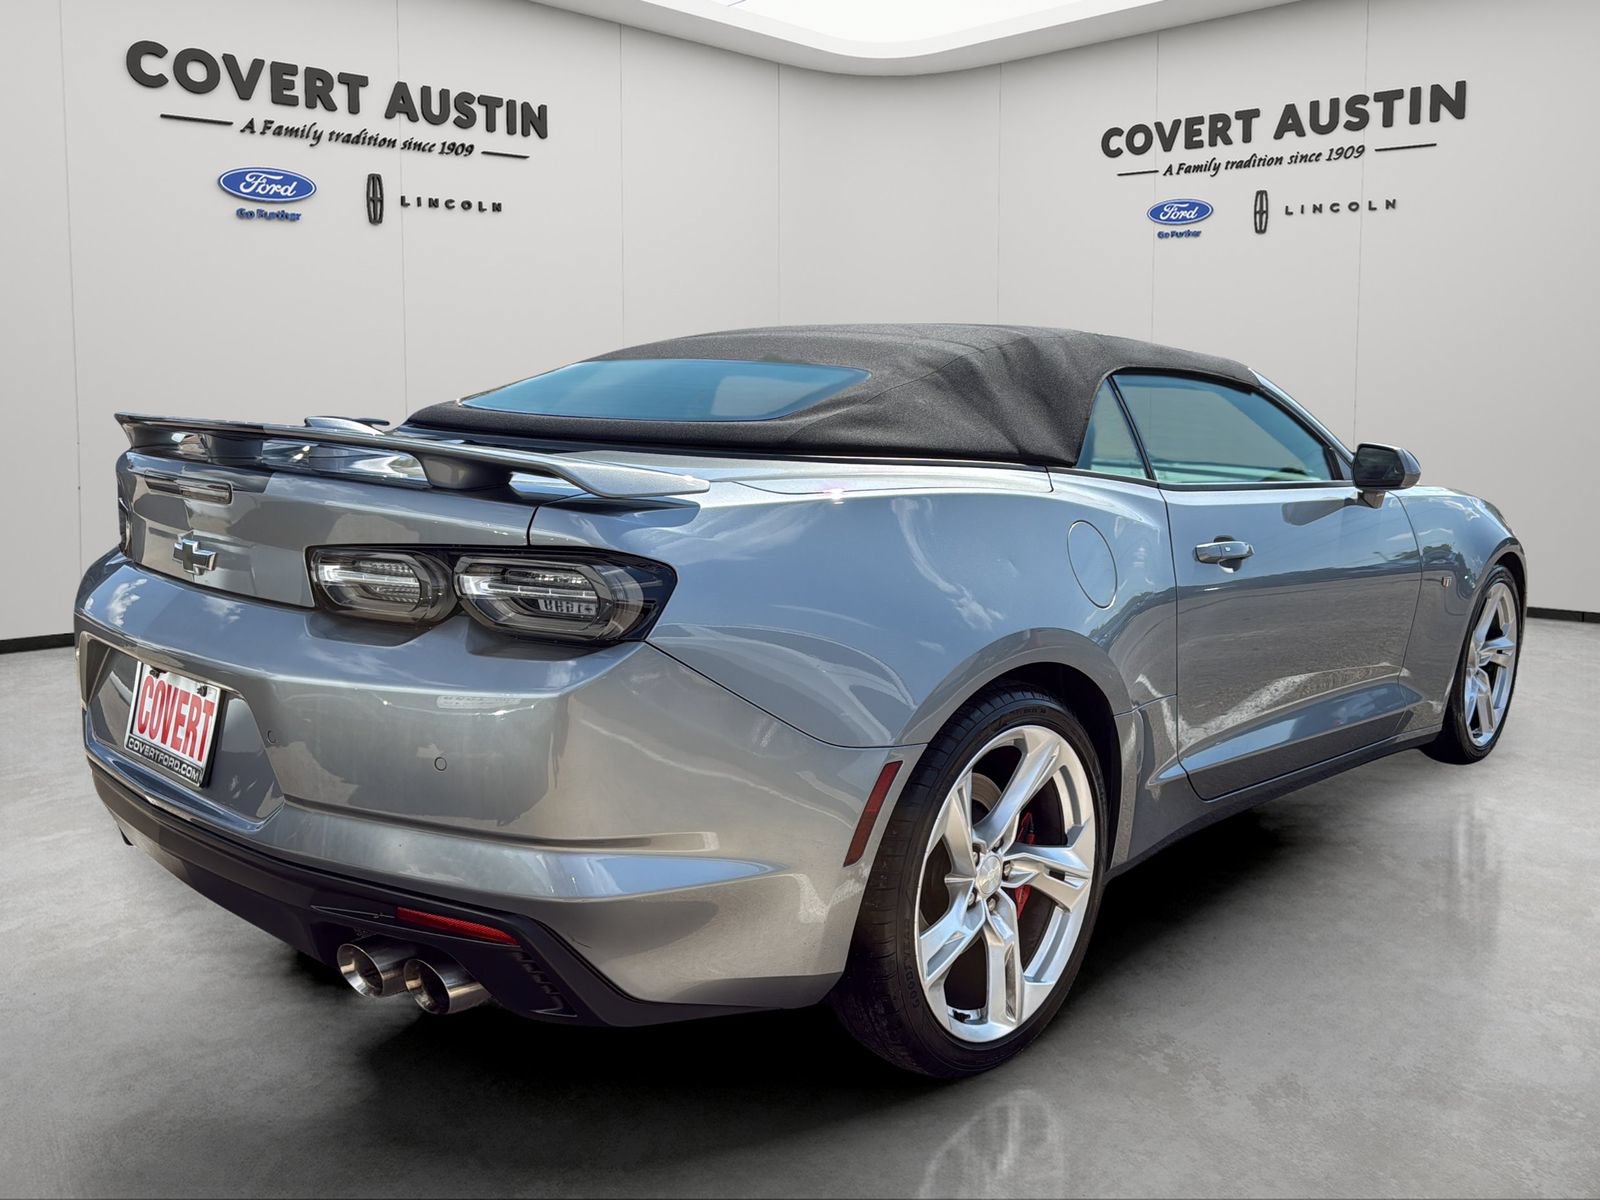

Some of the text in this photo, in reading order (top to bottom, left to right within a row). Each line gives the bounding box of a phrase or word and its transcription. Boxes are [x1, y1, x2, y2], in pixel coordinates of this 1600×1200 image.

[126, 40, 548, 140] COVERT AUSTIN
[1101, 80, 1467, 159] COVERT AUSTIN
[239, 119, 475, 158] A Family tradition since 1909
[1163, 144, 1366, 178] A Family tradition since 1909
[239, 173, 298, 198] Ford
[400, 195, 503, 213] LINCOLN
[1159, 204, 1199, 221] Ford
[1285, 198, 1398, 216] LINCOLN
[137, 675, 215, 763] COVERT
[128, 738, 200, 782] COVERTFORD.COM
